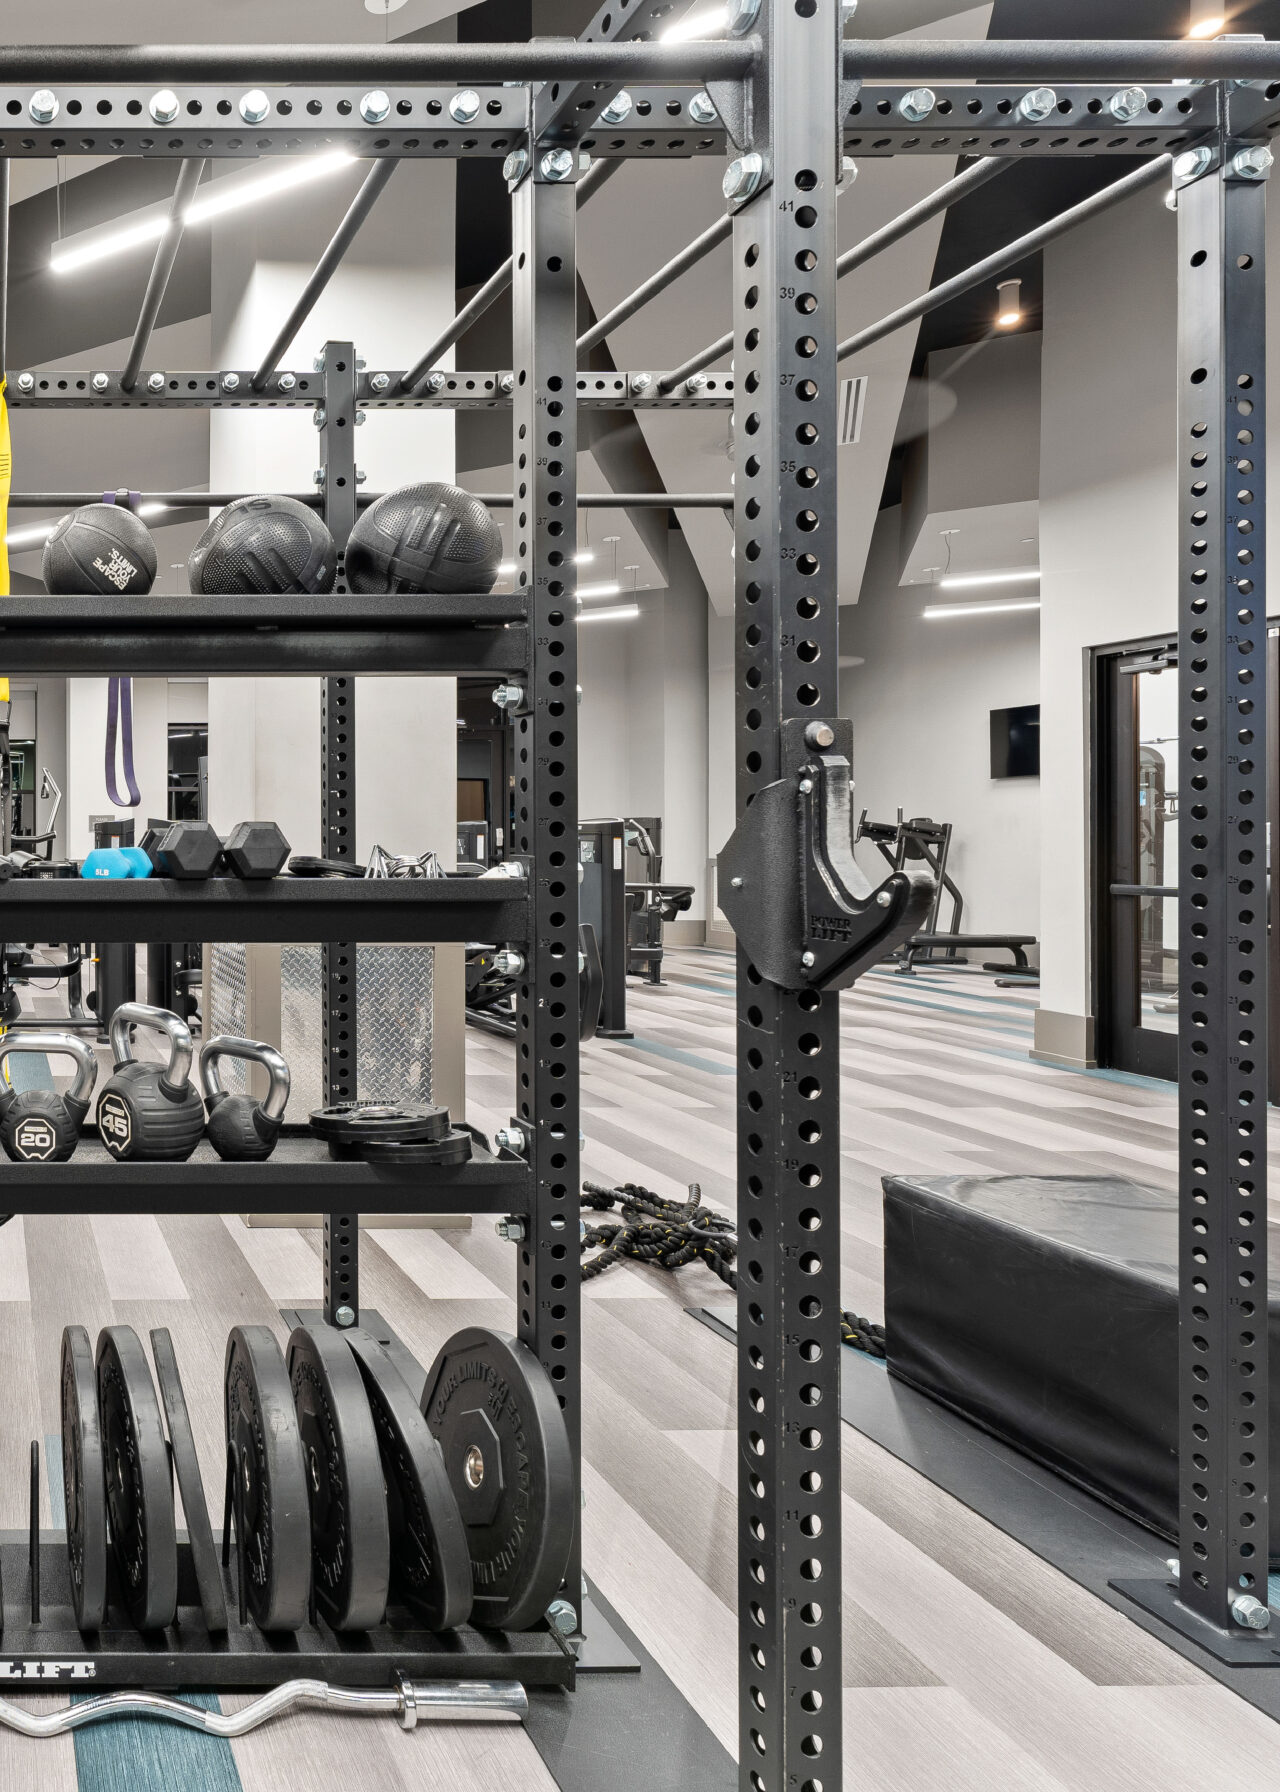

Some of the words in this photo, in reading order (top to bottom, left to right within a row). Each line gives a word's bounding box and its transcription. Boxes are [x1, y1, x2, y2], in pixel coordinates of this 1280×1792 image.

[779, 199, 795, 214] 41
[779, 286, 795, 300] 39
[780, 373, 796, 387] 37
[536, 397, 548, 407] 41
[536, 456, 548, 466] 39
[780, 460, 796, 474] 35
[537, 516, 549, 526] 37
[781, 547, 796, 561] 33
[93, 557, 127, 590] ESCAPE
[109, 559, 130, 583] YOUR
[537, 576, 549, 586] 35
[537, 636, 549, 647] 33
[781, 634, 797, 648] 31
[538, 756, 550, 767] 29
[538, 817, 550, 827] 27
[95, 868, 110, 876] 5LB
[810, 914, 852, 928] POWER
[810, 928, 853, 944] LIFT
[539, 998, 551, 1008] 21
[539, 1058, 551, 1068] 19
[783, 1071, 798, 1084] 21
[102, 1114, 128, 1138] 45
[20, 1133, 51, 1147] 20
[783, 1159, 799, 1172] 19
[539, 1179, 551, 1189] 15
[540, 1240, 552, 1250] 13
[784, 1246, 799, 1259] 17
[784, 1333, 799, 1347] 15
[785, 1421, 800, 1434] 13
[785, 1509, 800, 1522] 11
[788, 1597, 797, 1610] 9
[788, 1685, 797, 1698] 7
[789, 1773, 797, 1787] 5
